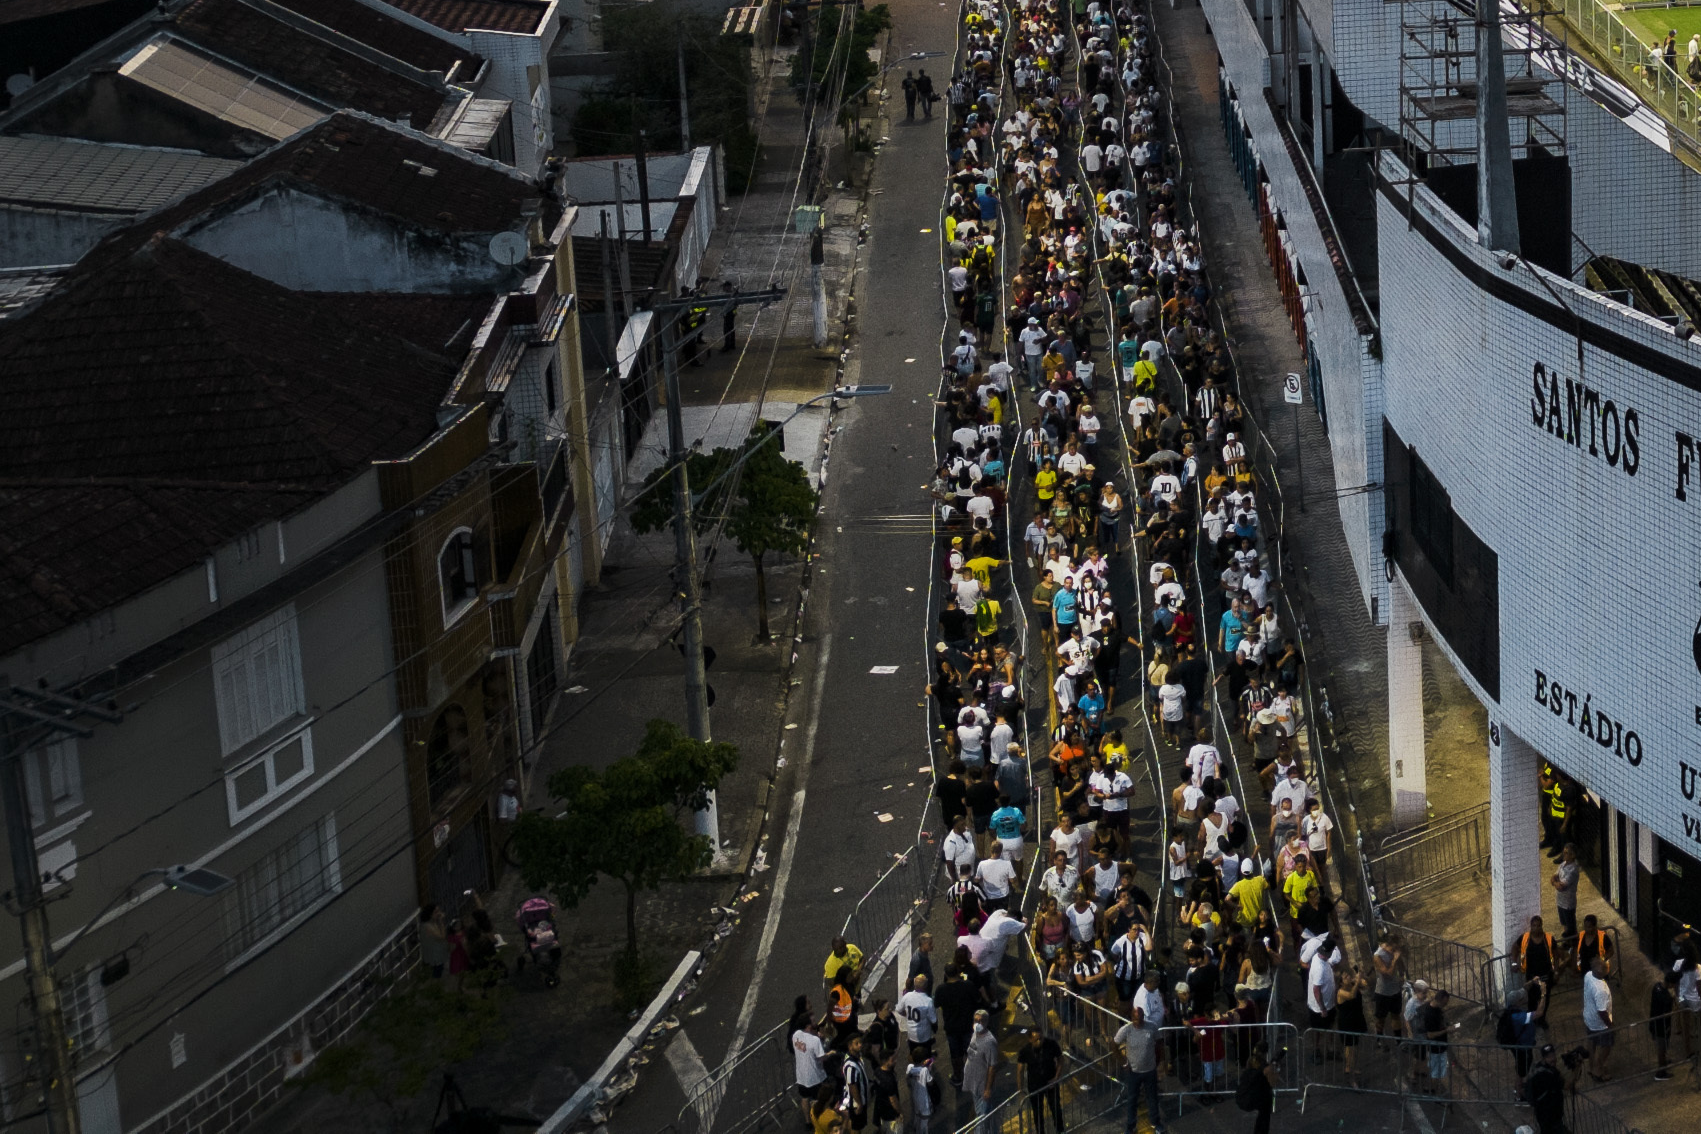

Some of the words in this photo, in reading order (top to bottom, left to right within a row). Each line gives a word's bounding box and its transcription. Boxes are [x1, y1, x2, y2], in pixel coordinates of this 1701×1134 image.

[1531, 361, 1640, 476] SANTOS
[1160, 482, 1172, 494] 10
[1535, 669, 1643, 766] ESTÁDIO
[907, 1004, 921, 1023] 10
